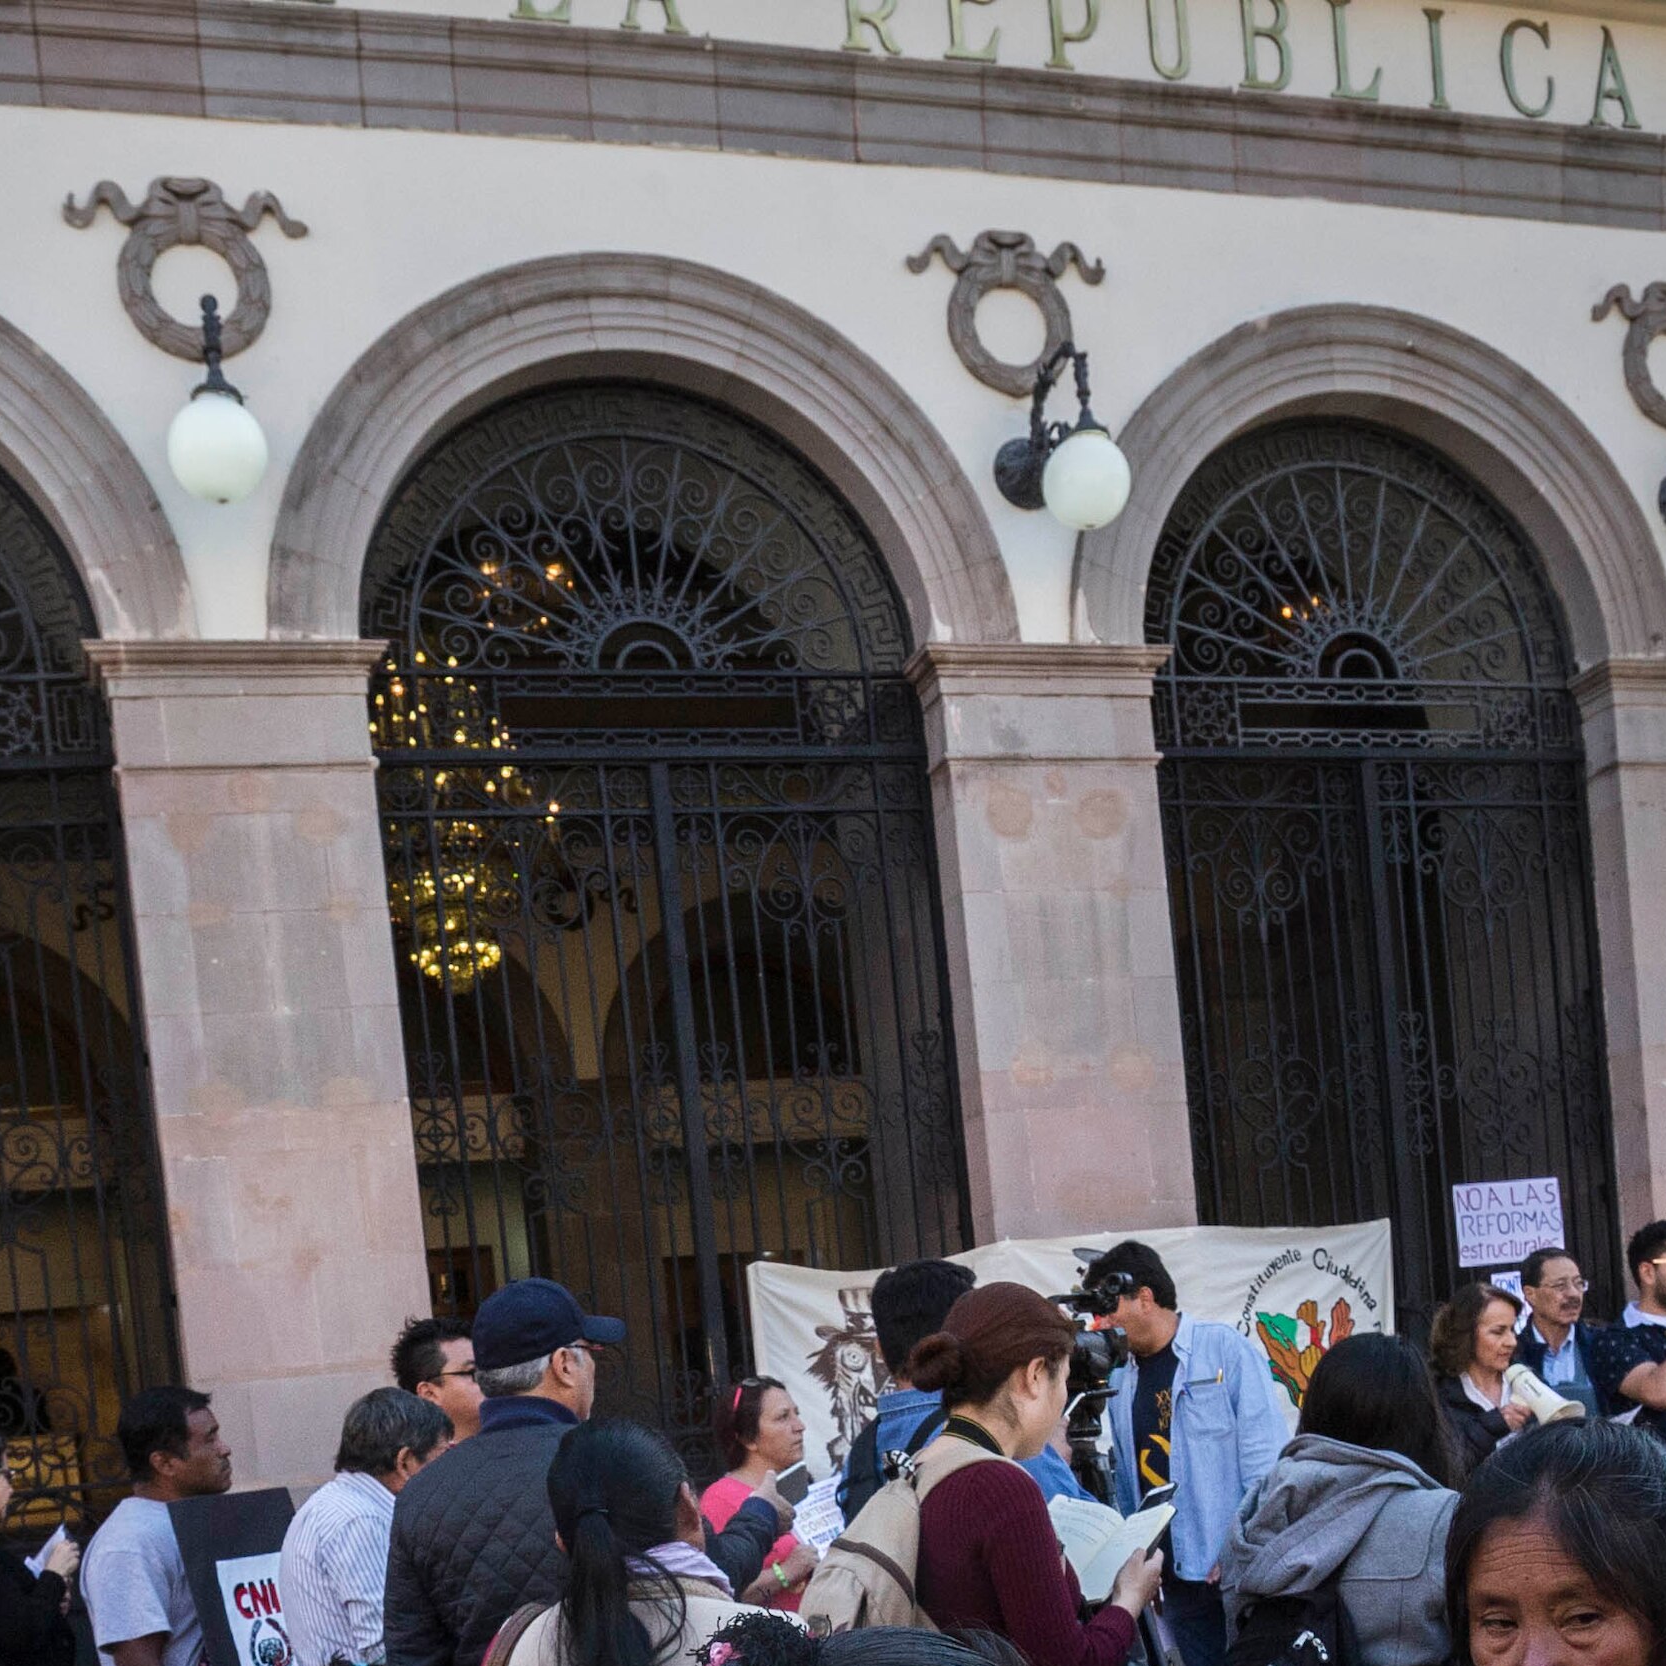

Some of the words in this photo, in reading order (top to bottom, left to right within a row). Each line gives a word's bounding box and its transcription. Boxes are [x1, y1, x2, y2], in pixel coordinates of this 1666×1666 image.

[1456, 1187, 1482, 1214] NO
[1487, 1186, 1503, 1209] A
[1510, 1183, 1556, 1207] LAS
[1460, 1207, 1562, 1238] REFORMAS
[1237, 1249, 1302, 1337] Constituyente
[234, 1578, 281, 1619] CNI
